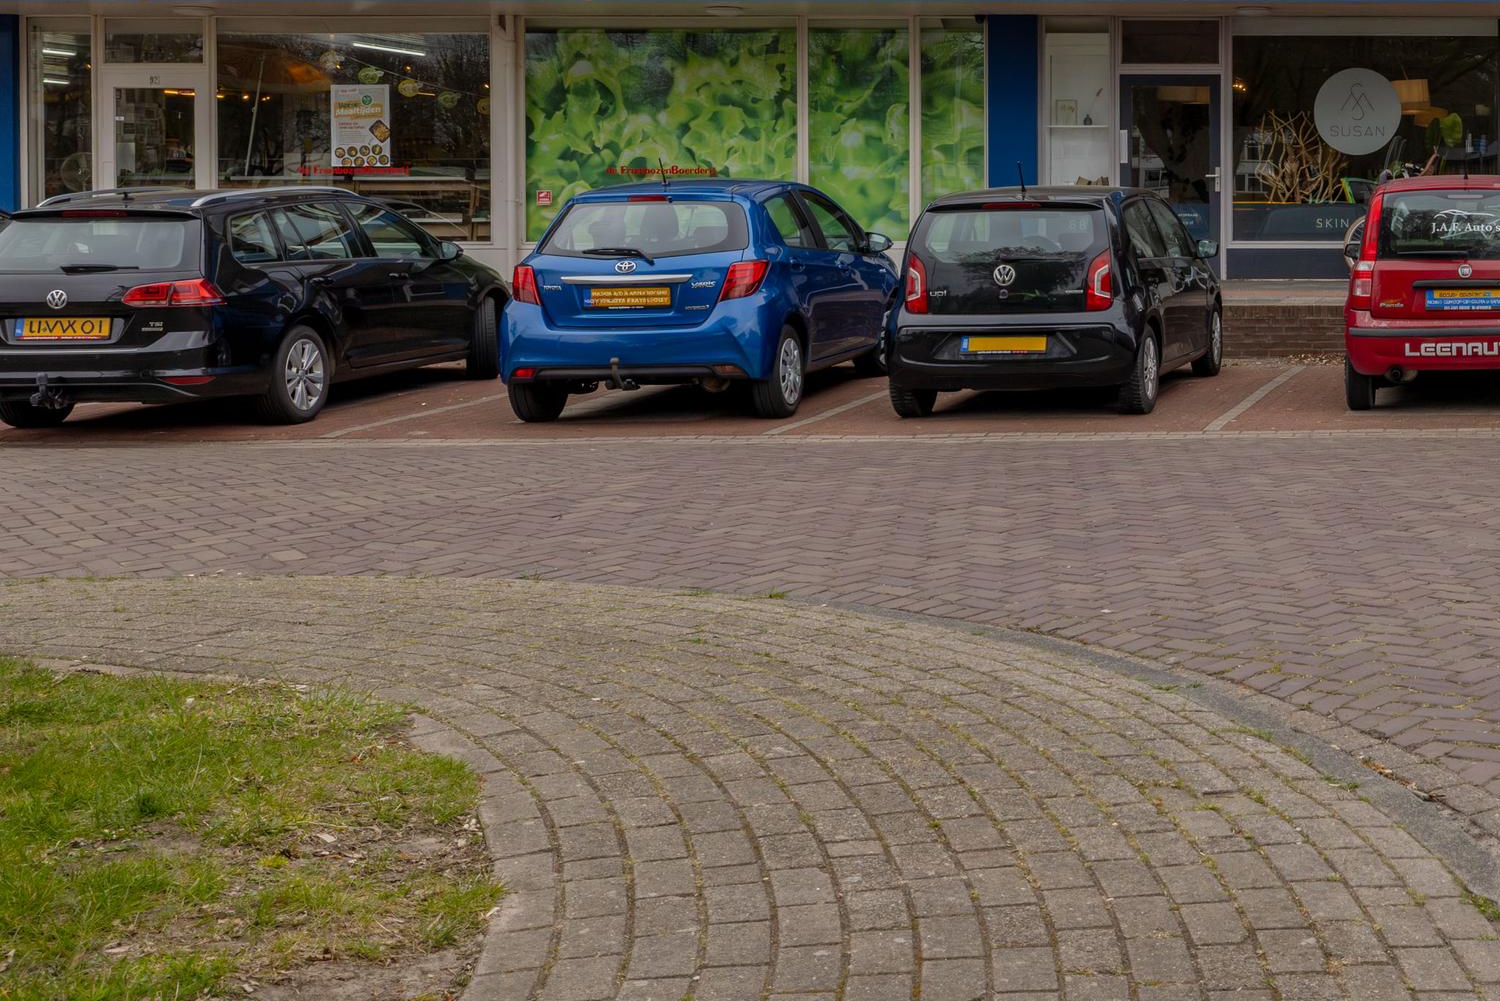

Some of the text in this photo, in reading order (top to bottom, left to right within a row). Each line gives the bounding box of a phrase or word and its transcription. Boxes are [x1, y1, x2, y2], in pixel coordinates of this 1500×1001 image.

[1329, 125, 1385, 137] SUSAN
[1315, 218, 1349, 228] SKIN
[1431, 222, 1500, 234] J.A.F. Auto's
